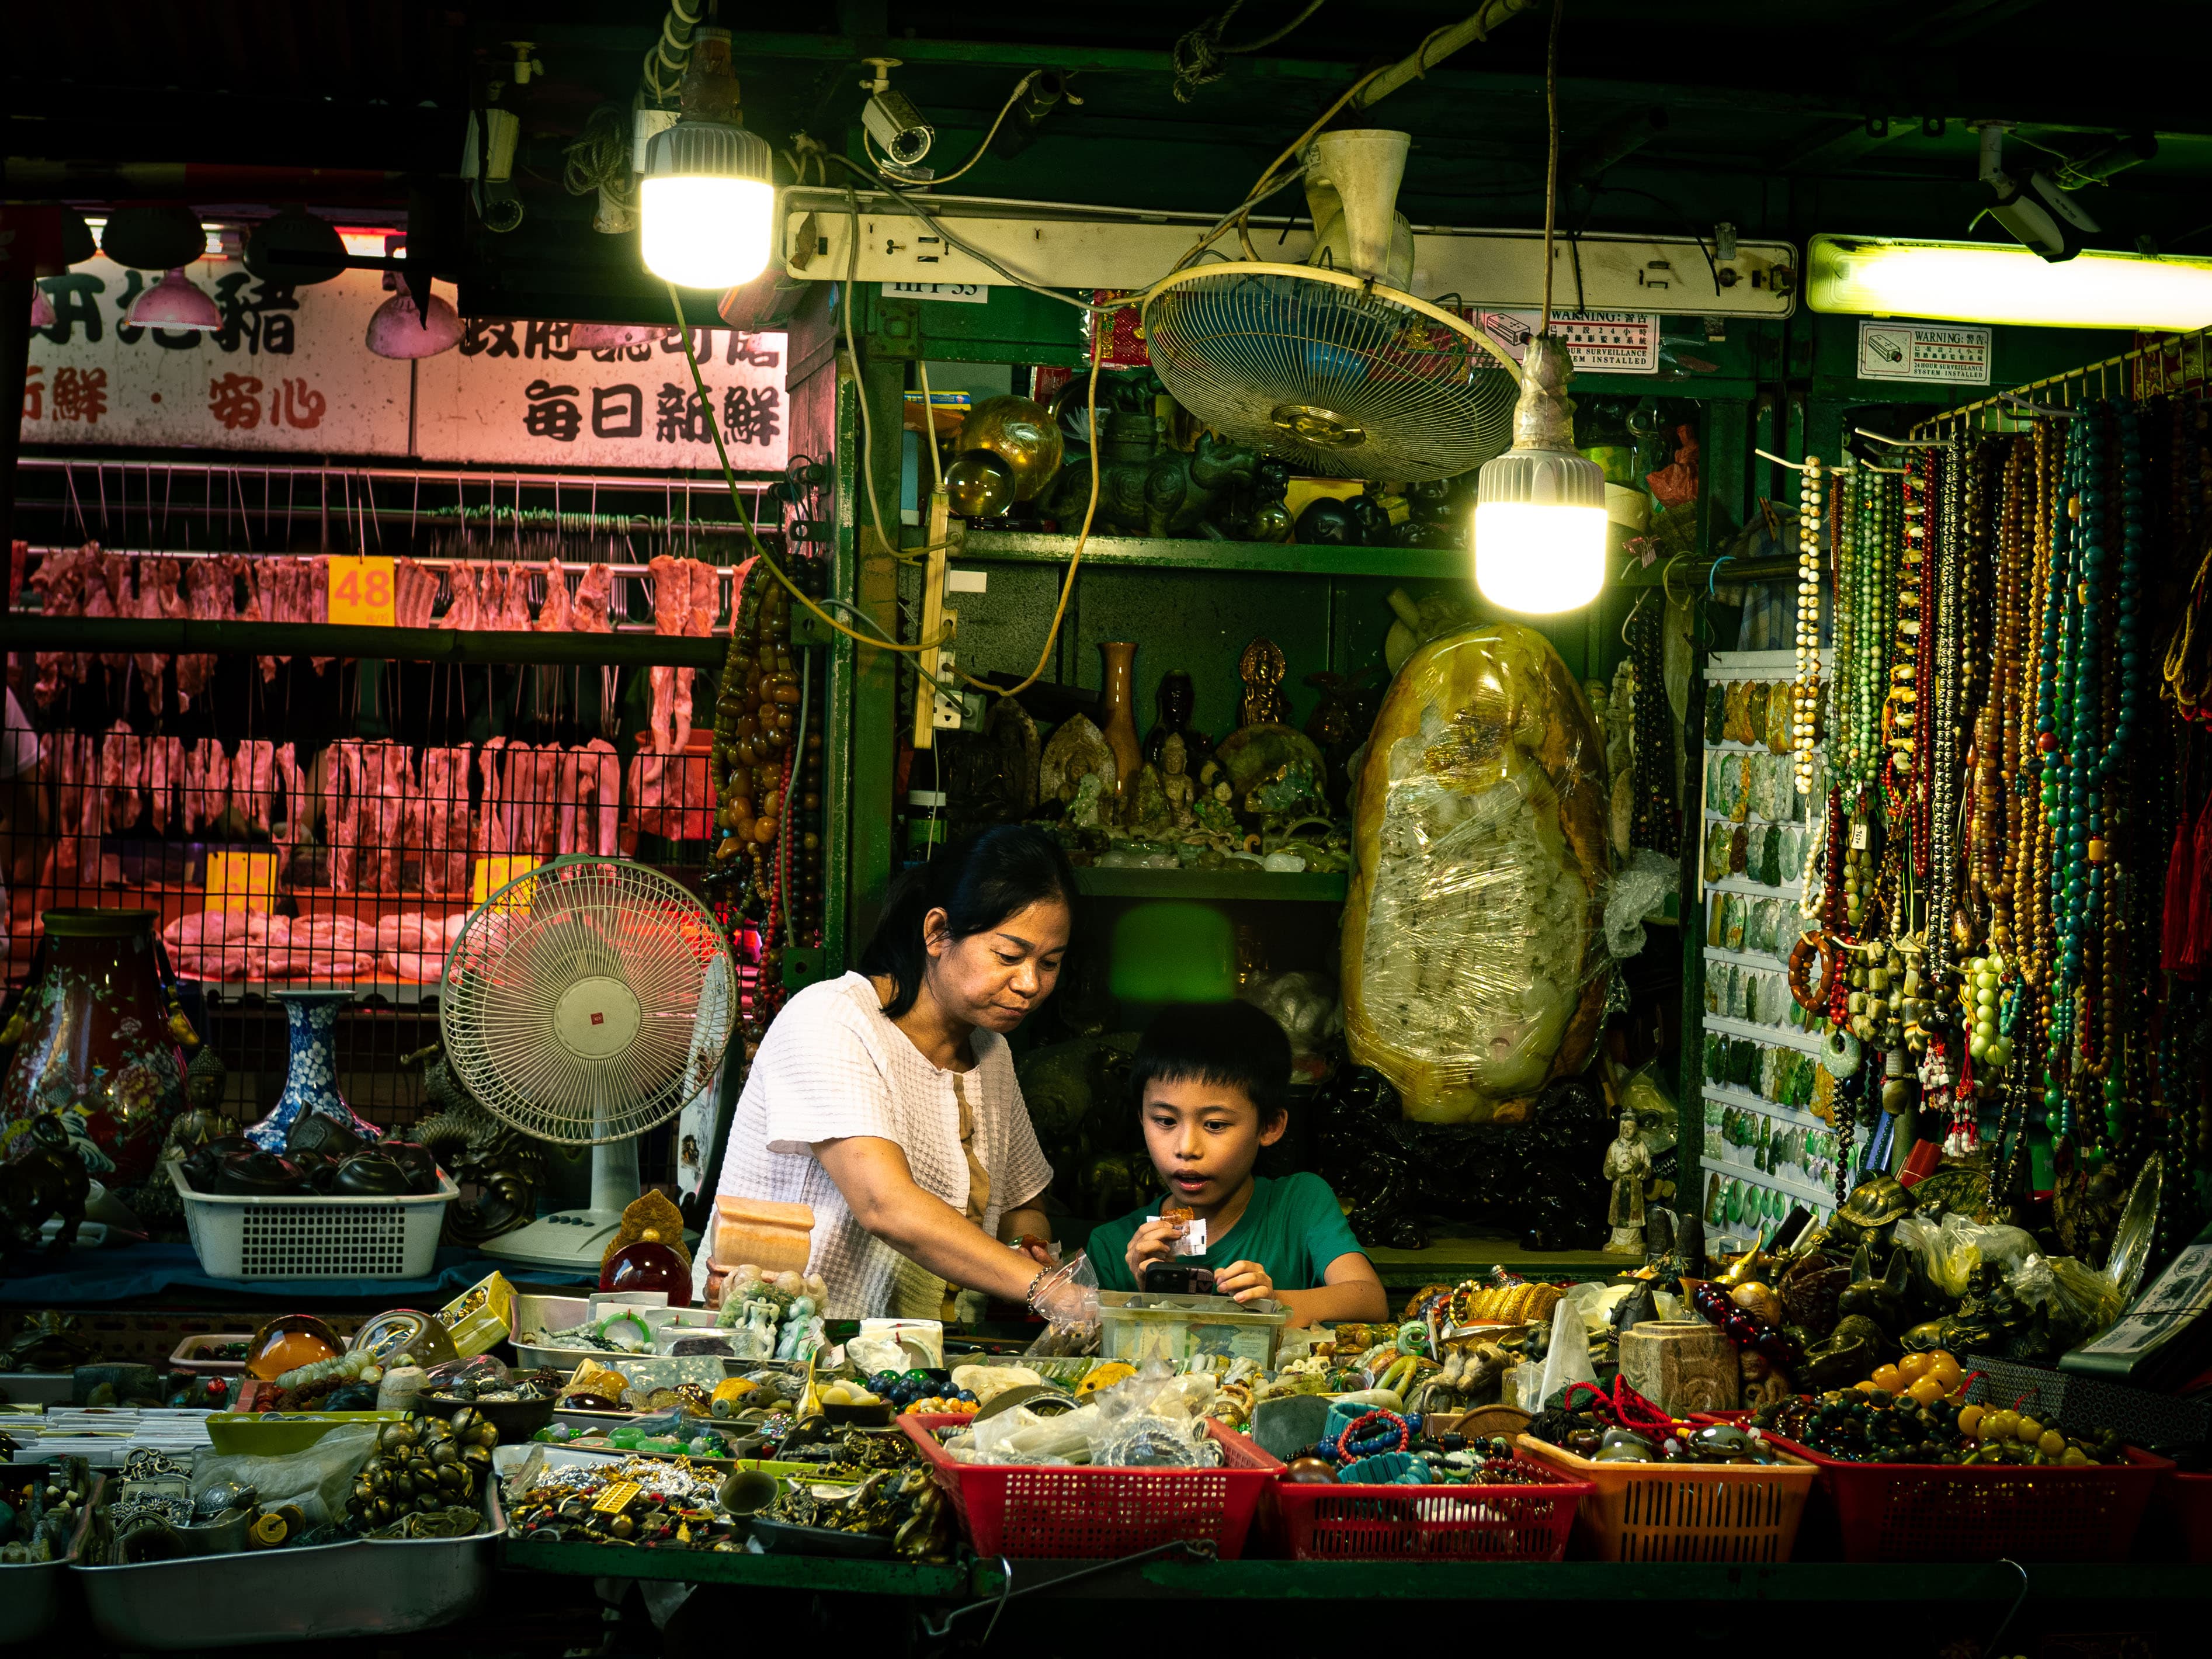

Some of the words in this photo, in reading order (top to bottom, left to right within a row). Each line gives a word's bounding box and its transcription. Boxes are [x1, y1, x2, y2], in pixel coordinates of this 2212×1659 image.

[1551, 311, 1621, 322] WARNING:
[1624, 313, 1647, 323] 警告
[460, 319, 779, 367] 政府可
[1562, 334, 1647, 345] 錄影監察系統
[1915, 331, 1964, 343] WARNING:
[1586, 348, 1647, 357] SURVEILLANCE
[335, 570, 391, 608] 48
